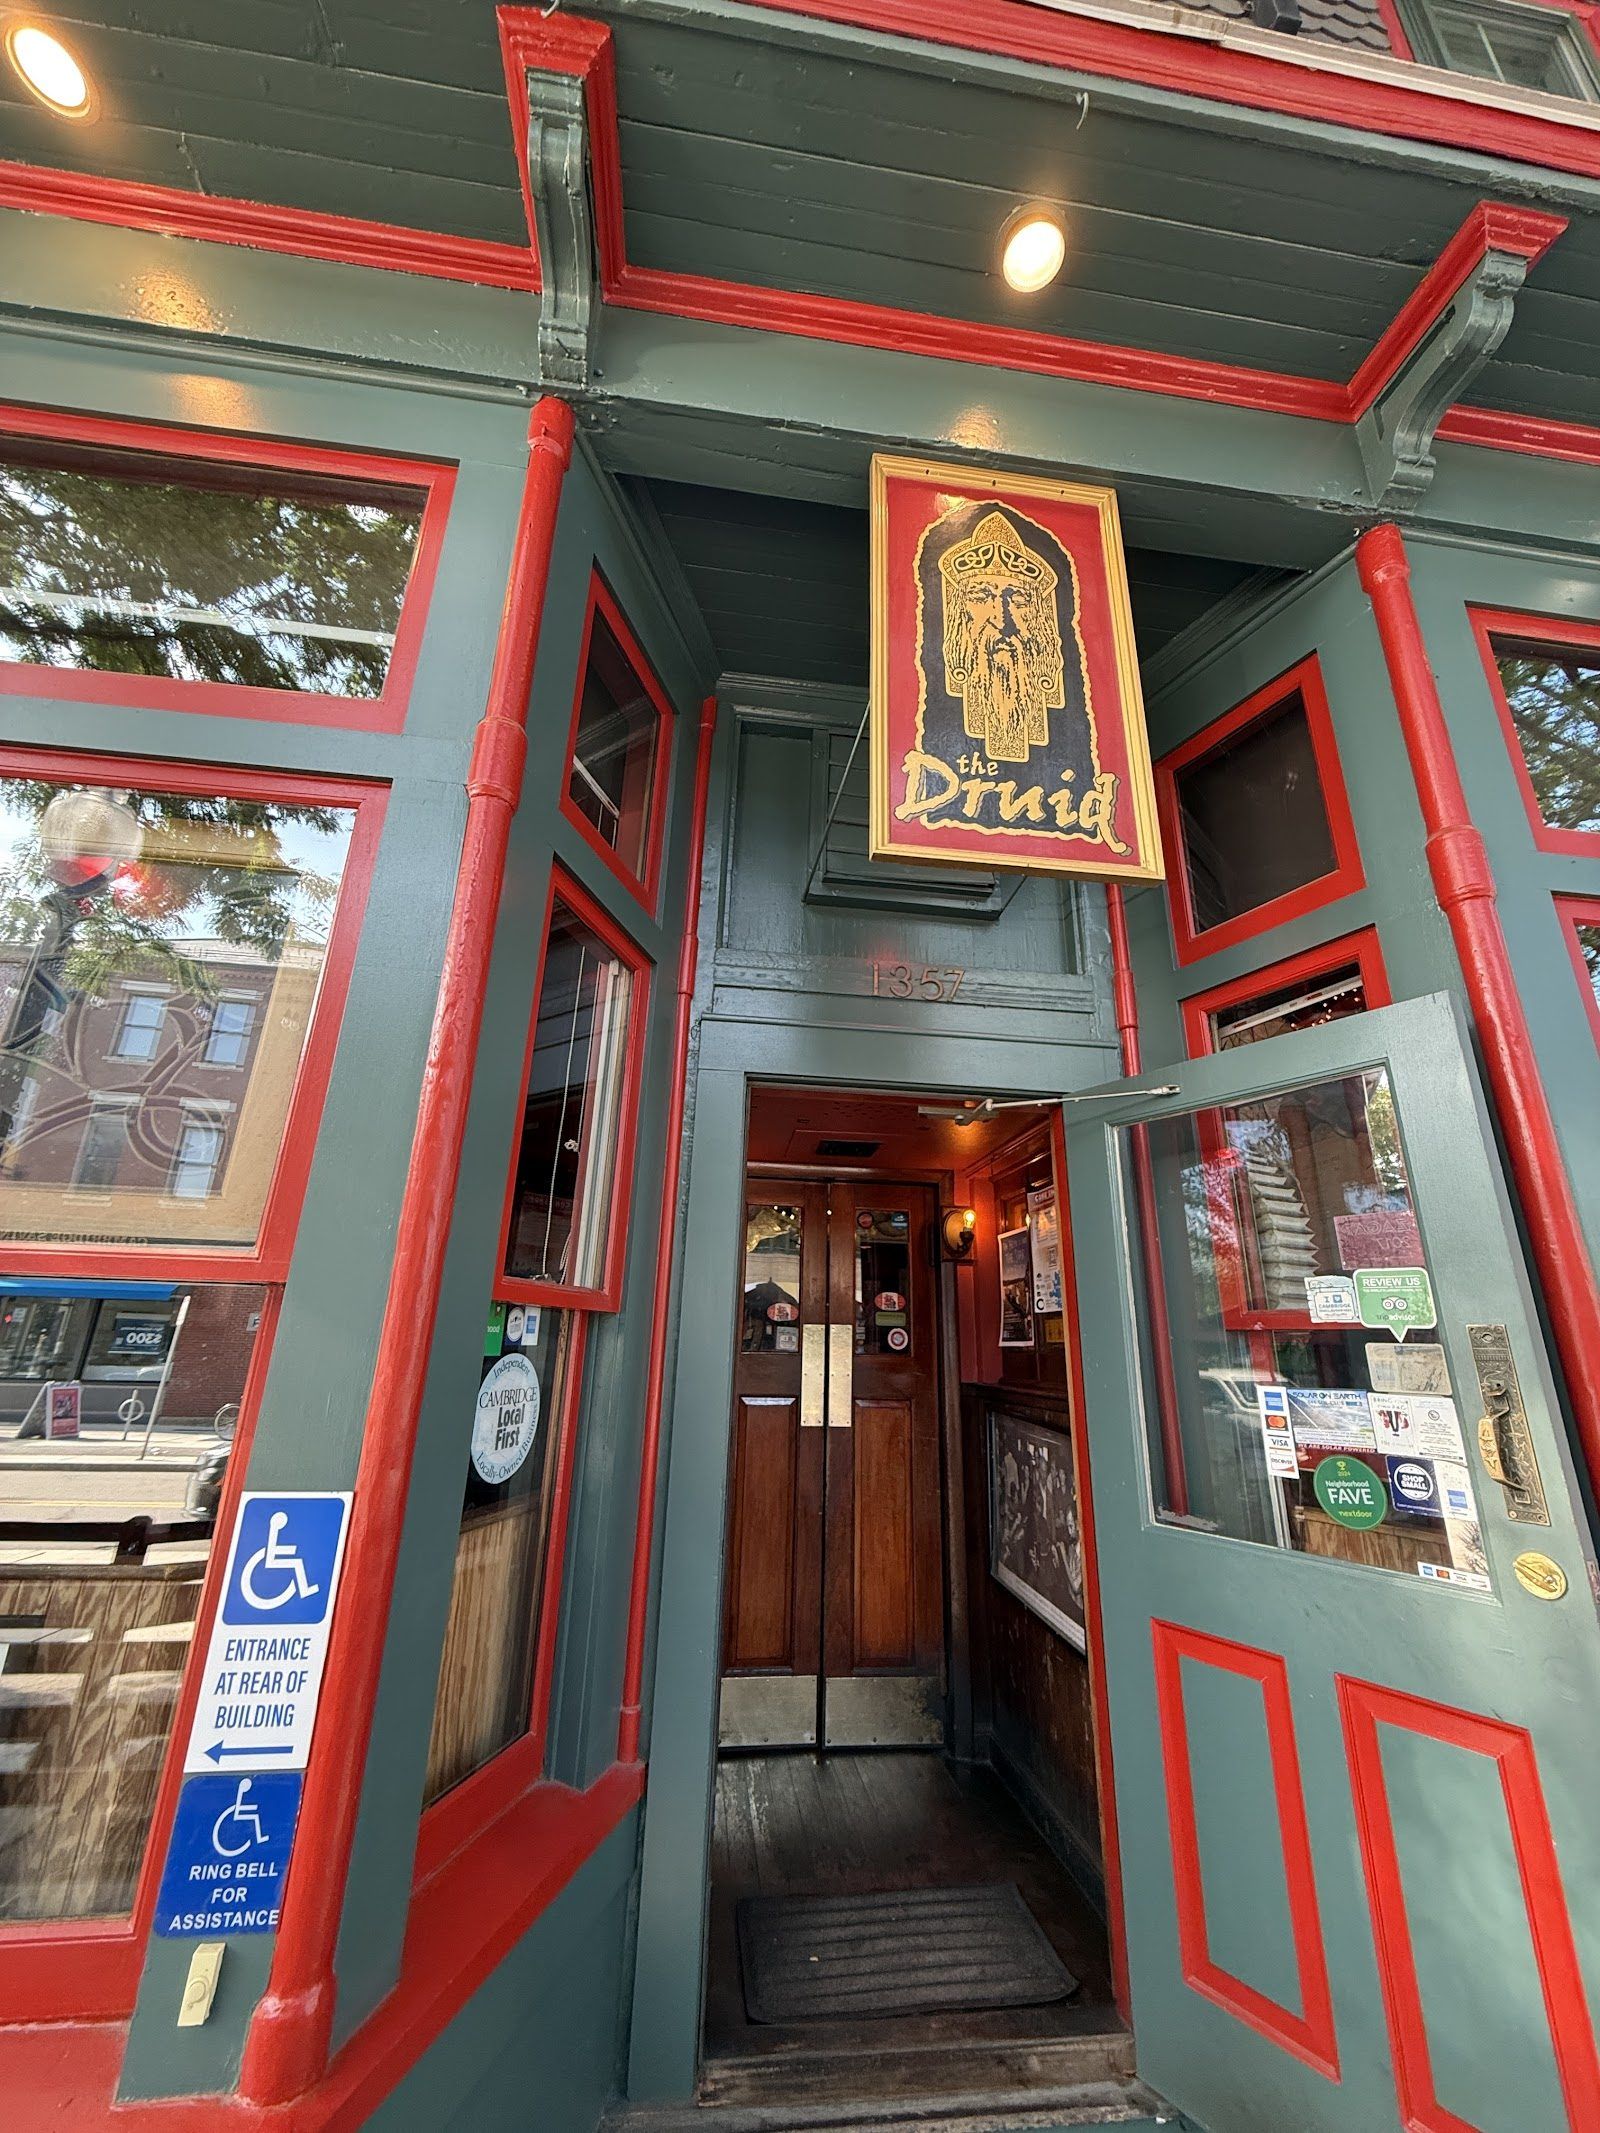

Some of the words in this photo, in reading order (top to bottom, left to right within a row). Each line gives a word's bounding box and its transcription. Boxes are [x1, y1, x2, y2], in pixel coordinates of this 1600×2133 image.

[958, 752, 998, 776] the
[894, 750, 1133, 857] Druid
[871, 960, 965, 1002] 1357
[1363, 1278, 1402, 1287] REVIEW
[1406, 1278, 1421, 1286] US
[493, 1357, 531, 1379] Independent
[479, 1386, 538, 1409] CAMBRIDGE
[1319, 1392, 1331, 1400] ON
[497, 1403, 526, 1429] Local
[495, 1428, 521, 1451] First
[1271, 1438, 1289, 1447] VISA
[1325, 1480, 1369, 1488] Neighborhood
[1401, 1480, 1428, 1491] SMALL
[1402, 1474, 1425, 1483] SHOP
[1328, 1488, 1374, 1505] FAVE
[1338, 1510, 1372, 1518] nextdoor
[225, 1637, 311, 1663] ENTRANCE
[214, 1672, 239, 1695] AT
[239, 1671, 282, 1695] REAR
[285, 1669, 308, 1694] OF
[215, 1704, 295, 1729] BUILDING
[189, 1864, 232, 1881] RING
[235, 1861, 279, 1879] BELL
[211, 1887, 248, 1904] FOR
[169, 1909, 280, 1931] ASSISTANCE
